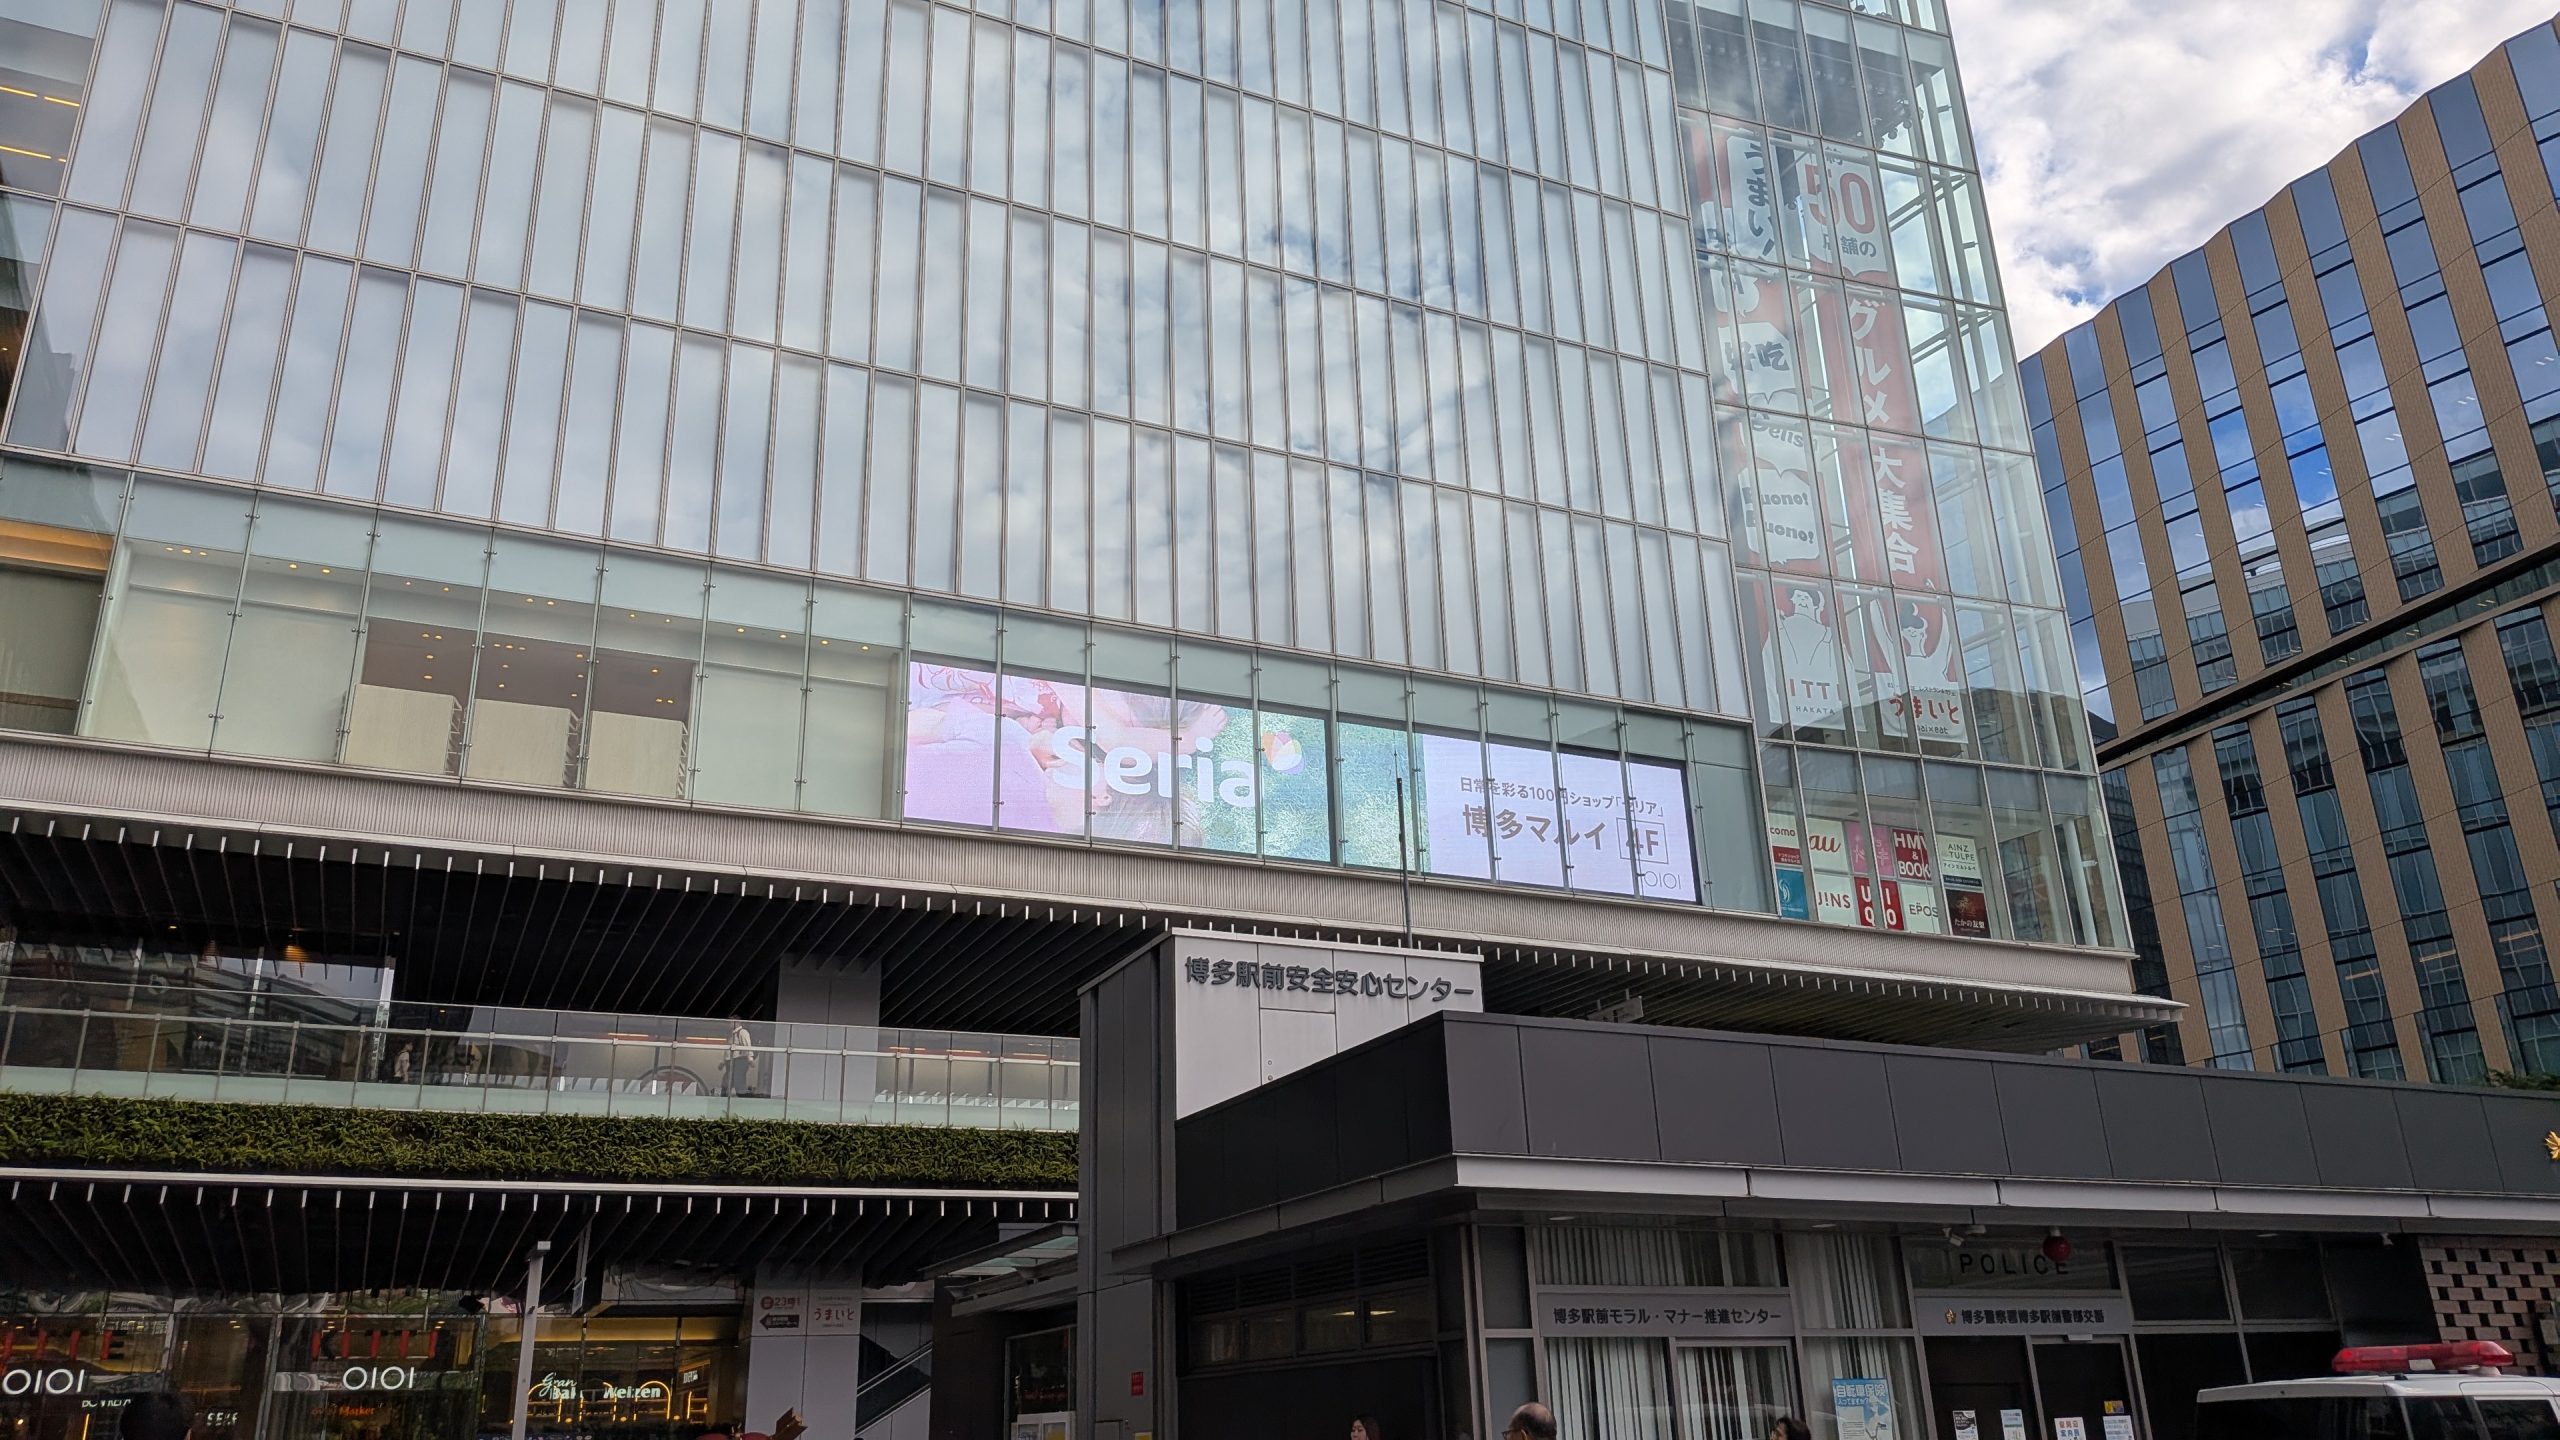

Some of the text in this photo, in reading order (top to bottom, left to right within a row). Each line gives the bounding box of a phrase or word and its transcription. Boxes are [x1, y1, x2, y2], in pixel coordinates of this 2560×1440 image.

[1804, 163, 1875, 234] 50
[1795, 705, 1835, 716] HAKATA
[1888, 694, 1959, 725] うまいと
[1051, 724, 1256, 809] Seria
[1462, 804, 1606, 851] 博多マルイ
[1626, 829, 1660, 857] 4F
[1809, 835, 1842, 853] au
[1185, 956, 1474, 1002] 博多駅前安全安心センター
[1959, 1252, 2069, 1275] POLICE
[814, 1308, 855, 1321] うまいと
[1553, 1307, 1782, 1326] 博多駅前モラル・マナー推進センター
[539, 1371, 577, 1397] Gran
